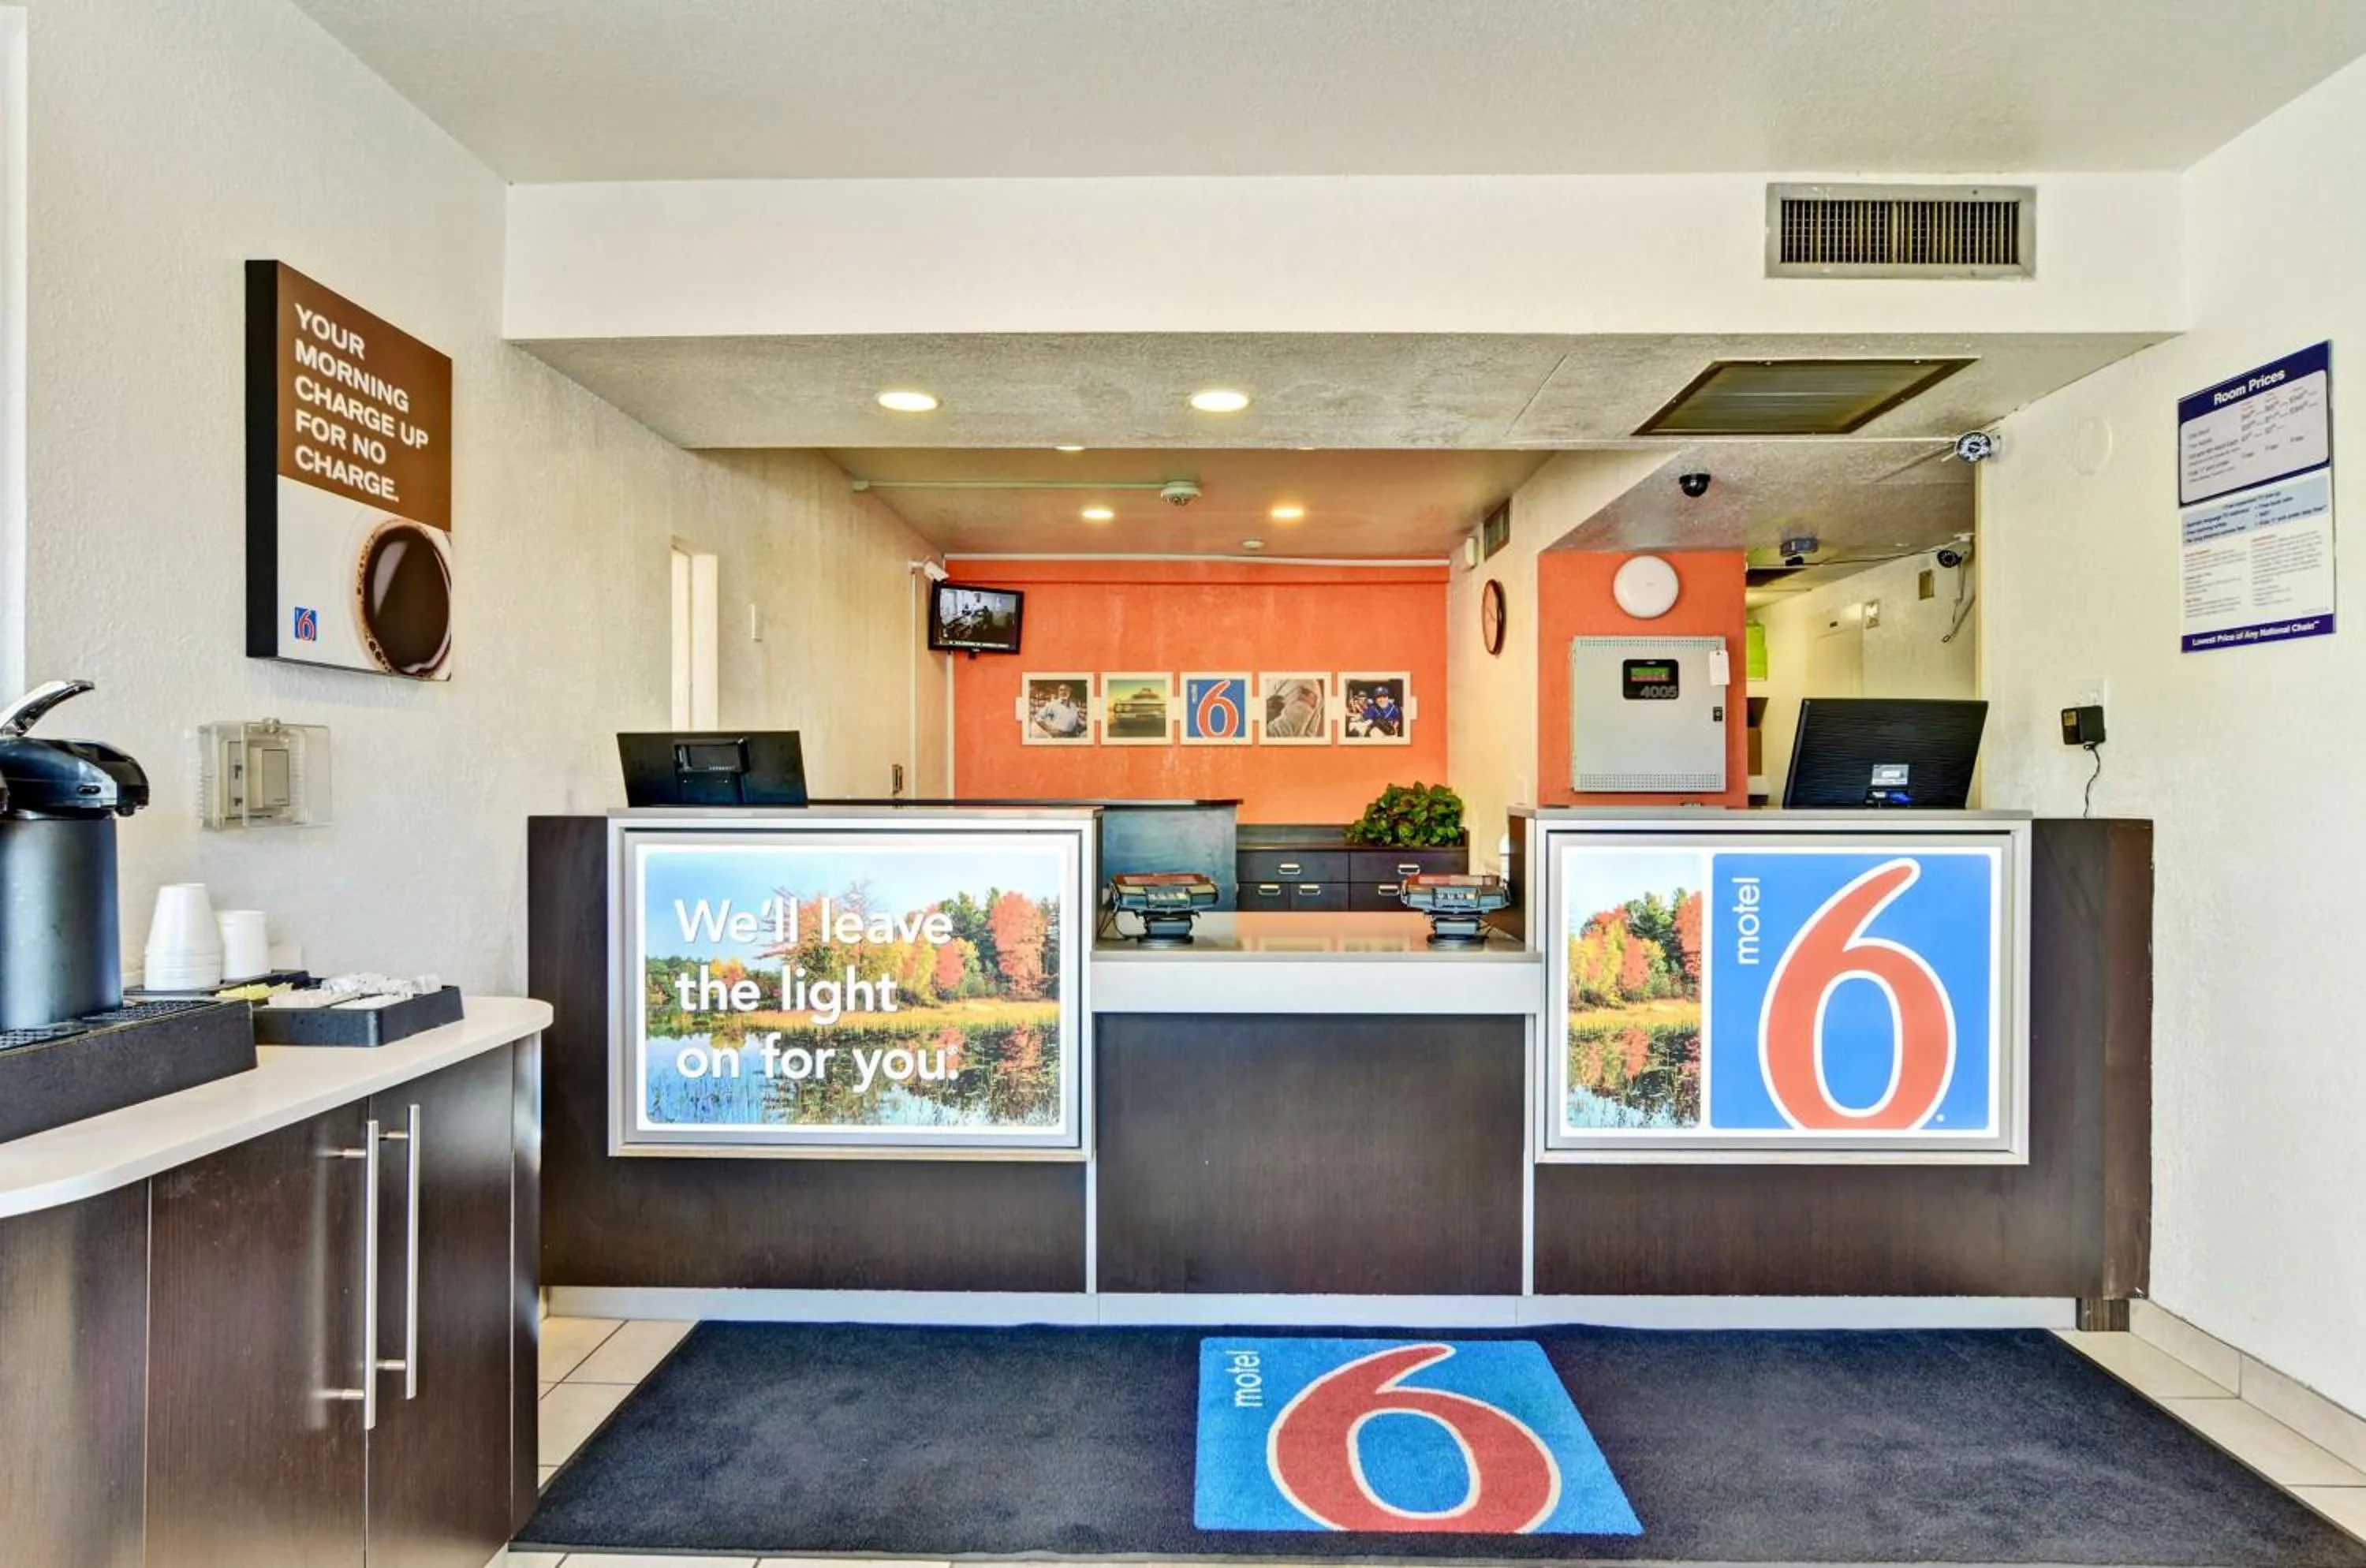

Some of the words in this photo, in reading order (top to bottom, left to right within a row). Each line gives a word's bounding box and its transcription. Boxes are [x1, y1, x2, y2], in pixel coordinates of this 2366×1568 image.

[294, 303, 365, 361] YOUR
[295, 338, 409, 414] MORNING
[2214, 385, 2246, 405] Room
[2248, 369, 2285, 392] Prices
[295, 375, 394, 439] CHARGE
[401, 421, 429, 450] UP
[295, 410, 346, 451] FOR
[353, 436, 386, 465] NO
[295, 445, 399, 502] CHARGE.
[297, 609, 316, 640] 6
[2217, 633, 2235, 643] Price
[2244, 630, 2259, 640] Any
[1196, 679, 1239, 738] 6
[1640, 685, 1677, 698] 4005
[674, 897, 798, 944] We'll
[822, 897, 953, 944] leave
[675, 965, 760, 1012] the
[782, 965, 898, 1025] light
[1732, 876, 1761, 965] motel
[1757, 857, 1957, 1130] 6
[676, 1046, 740, 1079] on
[760, 1032, 835, 1080] for
[1225, 1350, 1261, 1408] motel
[1267, 1343, 1562, 1534] 6
